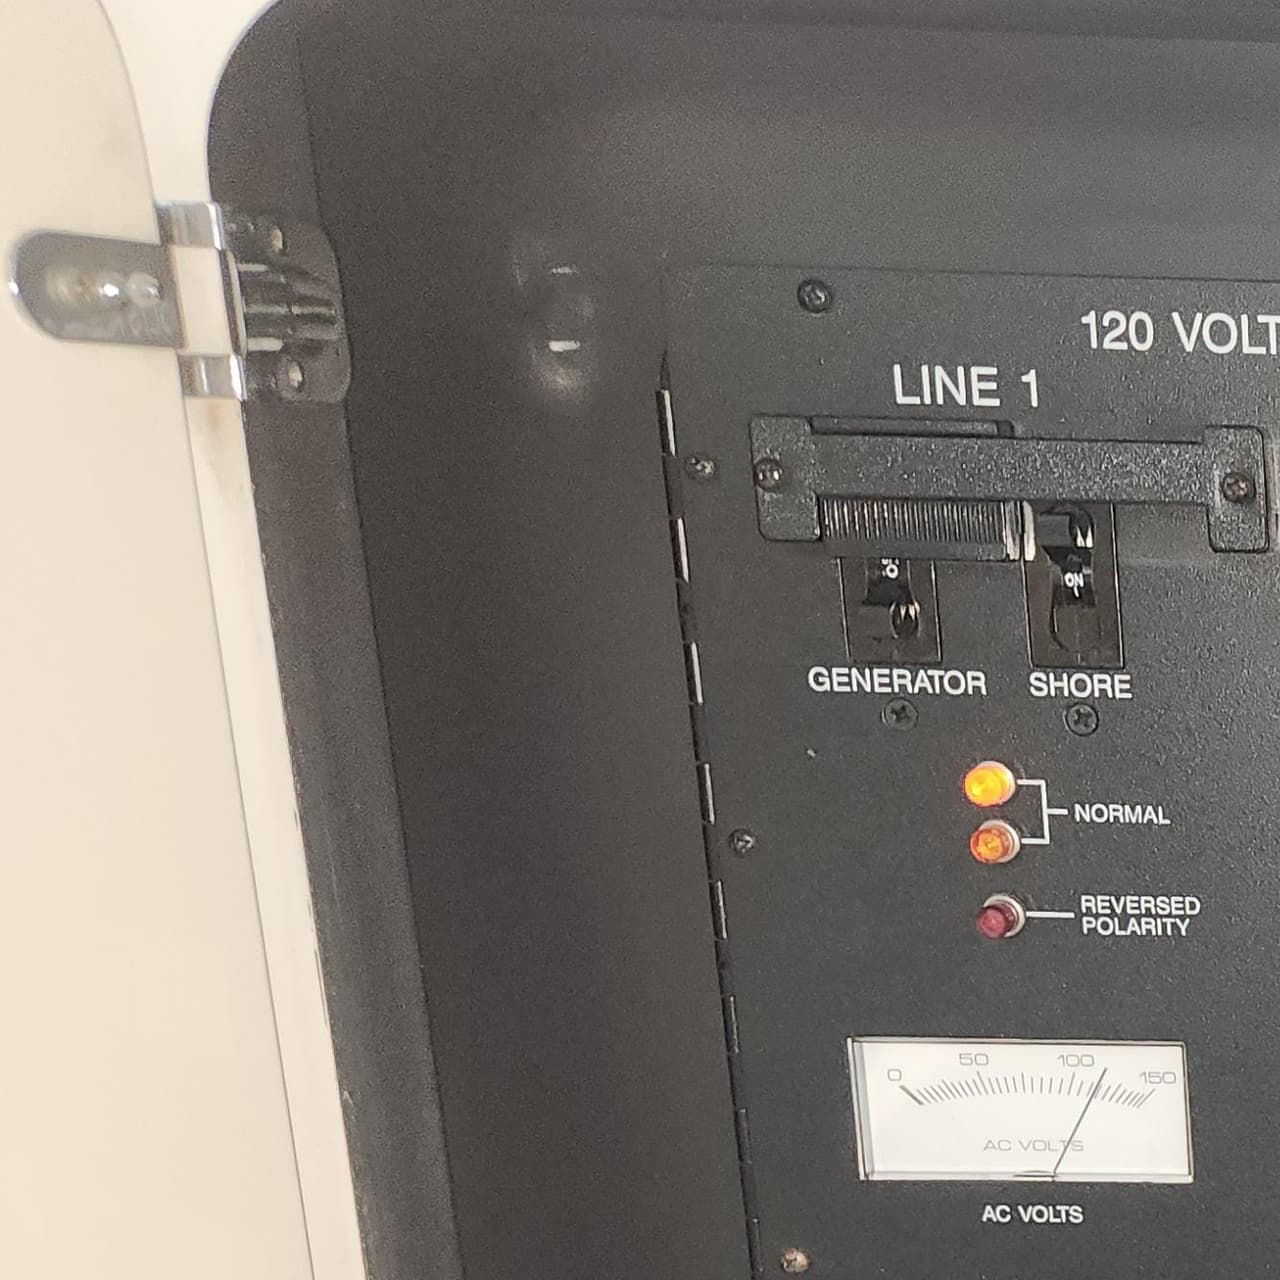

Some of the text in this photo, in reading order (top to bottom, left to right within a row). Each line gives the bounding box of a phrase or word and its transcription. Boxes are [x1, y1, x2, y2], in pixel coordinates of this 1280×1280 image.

[1082, 311, 1153, 350] 120
[894, 365, 1037, 407] LINE 1
[809, 667, 986, 695] GENERATOR
[1030, 672, 1132, 699] SHORE
[1075, 804, 1170, 824] NORMAL
[1081, 896, 1200, 915] REVERSED
[1083, 917, 1189, 936] POLARITY
[982, 1205, 1083, 1223] AC VOLTS
